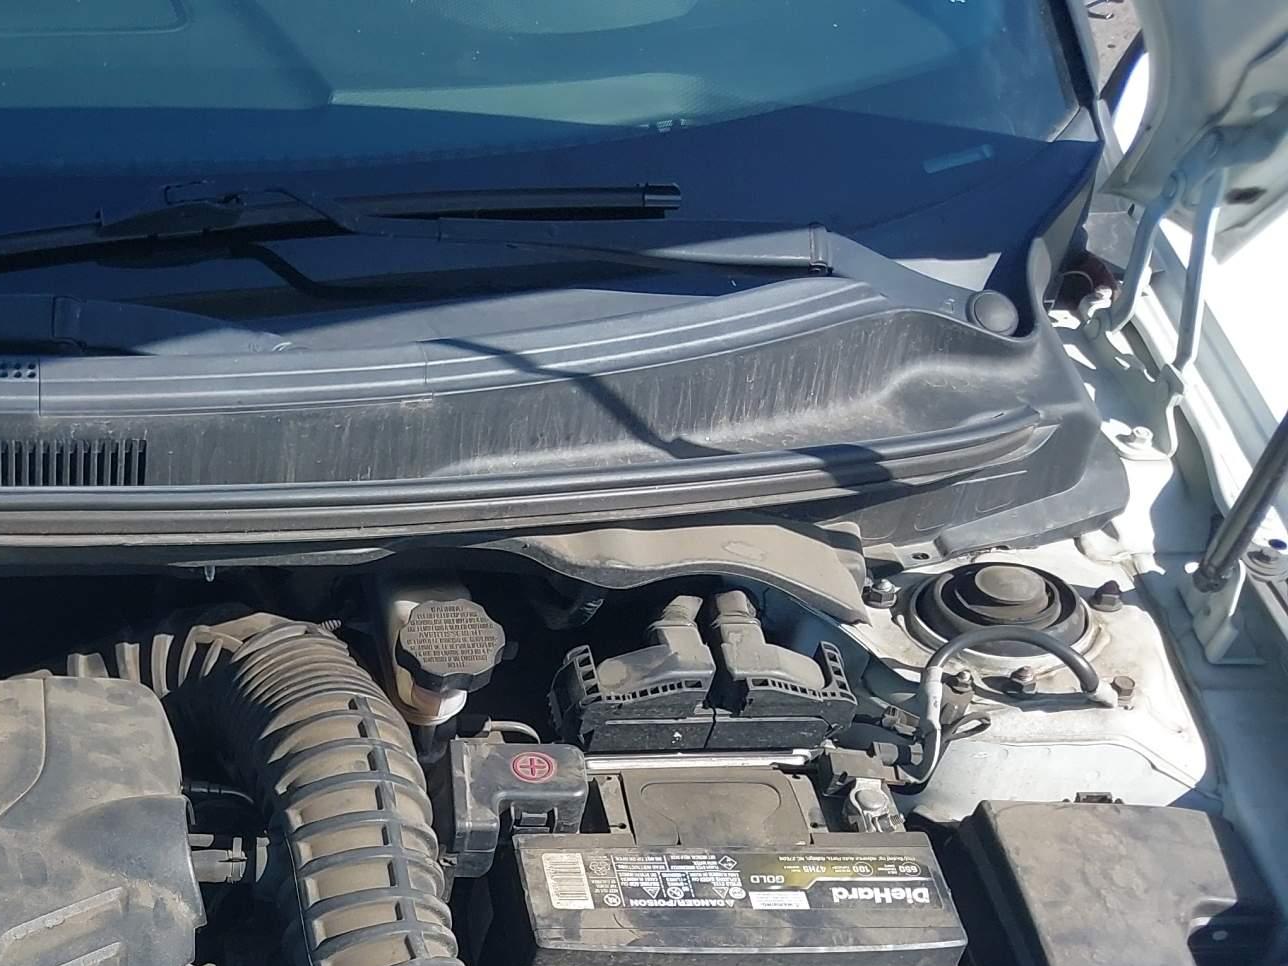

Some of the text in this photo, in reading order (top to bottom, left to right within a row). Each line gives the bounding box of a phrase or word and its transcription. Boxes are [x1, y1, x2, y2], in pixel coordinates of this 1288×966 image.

[853, 865, 871, 874] 100
[750, 874, 785, 885] GOLD
[829, 886, 930, 904] DieHard
[629, 899, 725, 907] DANGER/POISON
